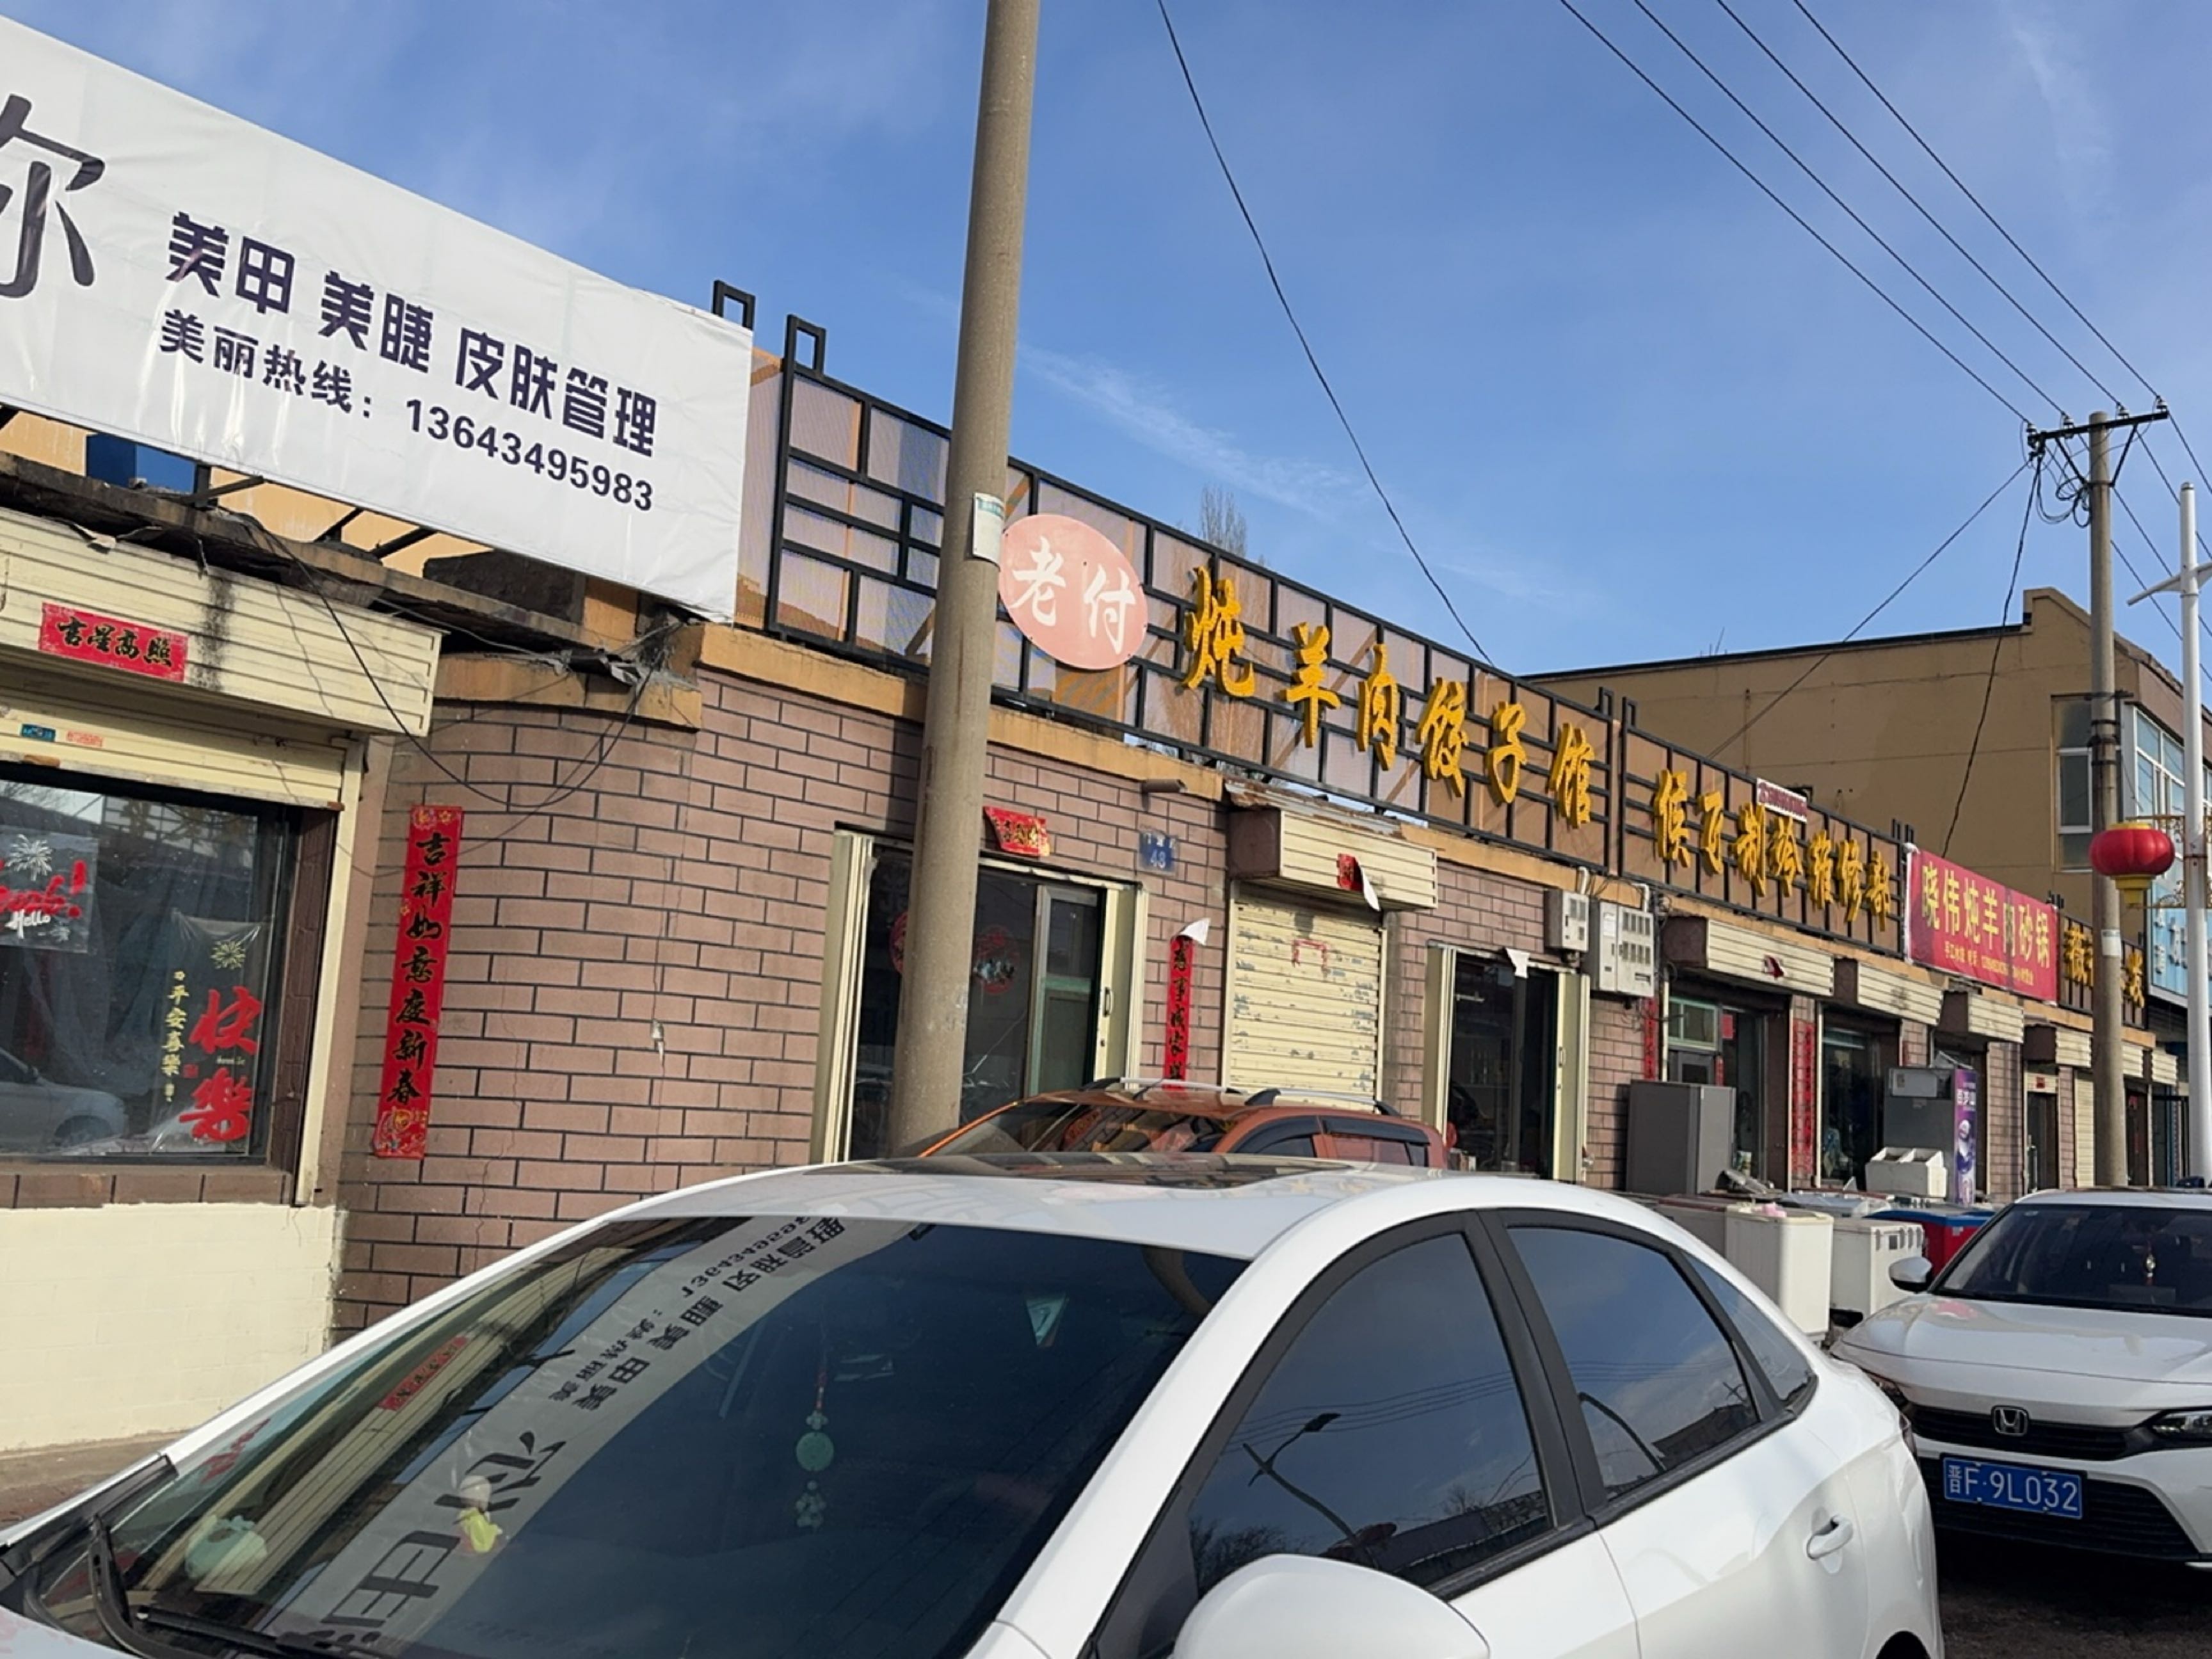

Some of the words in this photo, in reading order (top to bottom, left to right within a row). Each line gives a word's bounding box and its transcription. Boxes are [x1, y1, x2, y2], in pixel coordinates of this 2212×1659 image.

[165, 211, 295, 314] 美甲
[318, 270, 433, 374] 美睫
[455, 327, 657, 457] 皮肤管理
[406, 398, 653, 511] 13643495983
[58, 616, 172, 667] 吉星高照
[1010, 535, 1137, 655] 老付
[1182, 565, 1595, 830] 炖羊肉饺子馆
[4, 909, 51, 939] Hello
